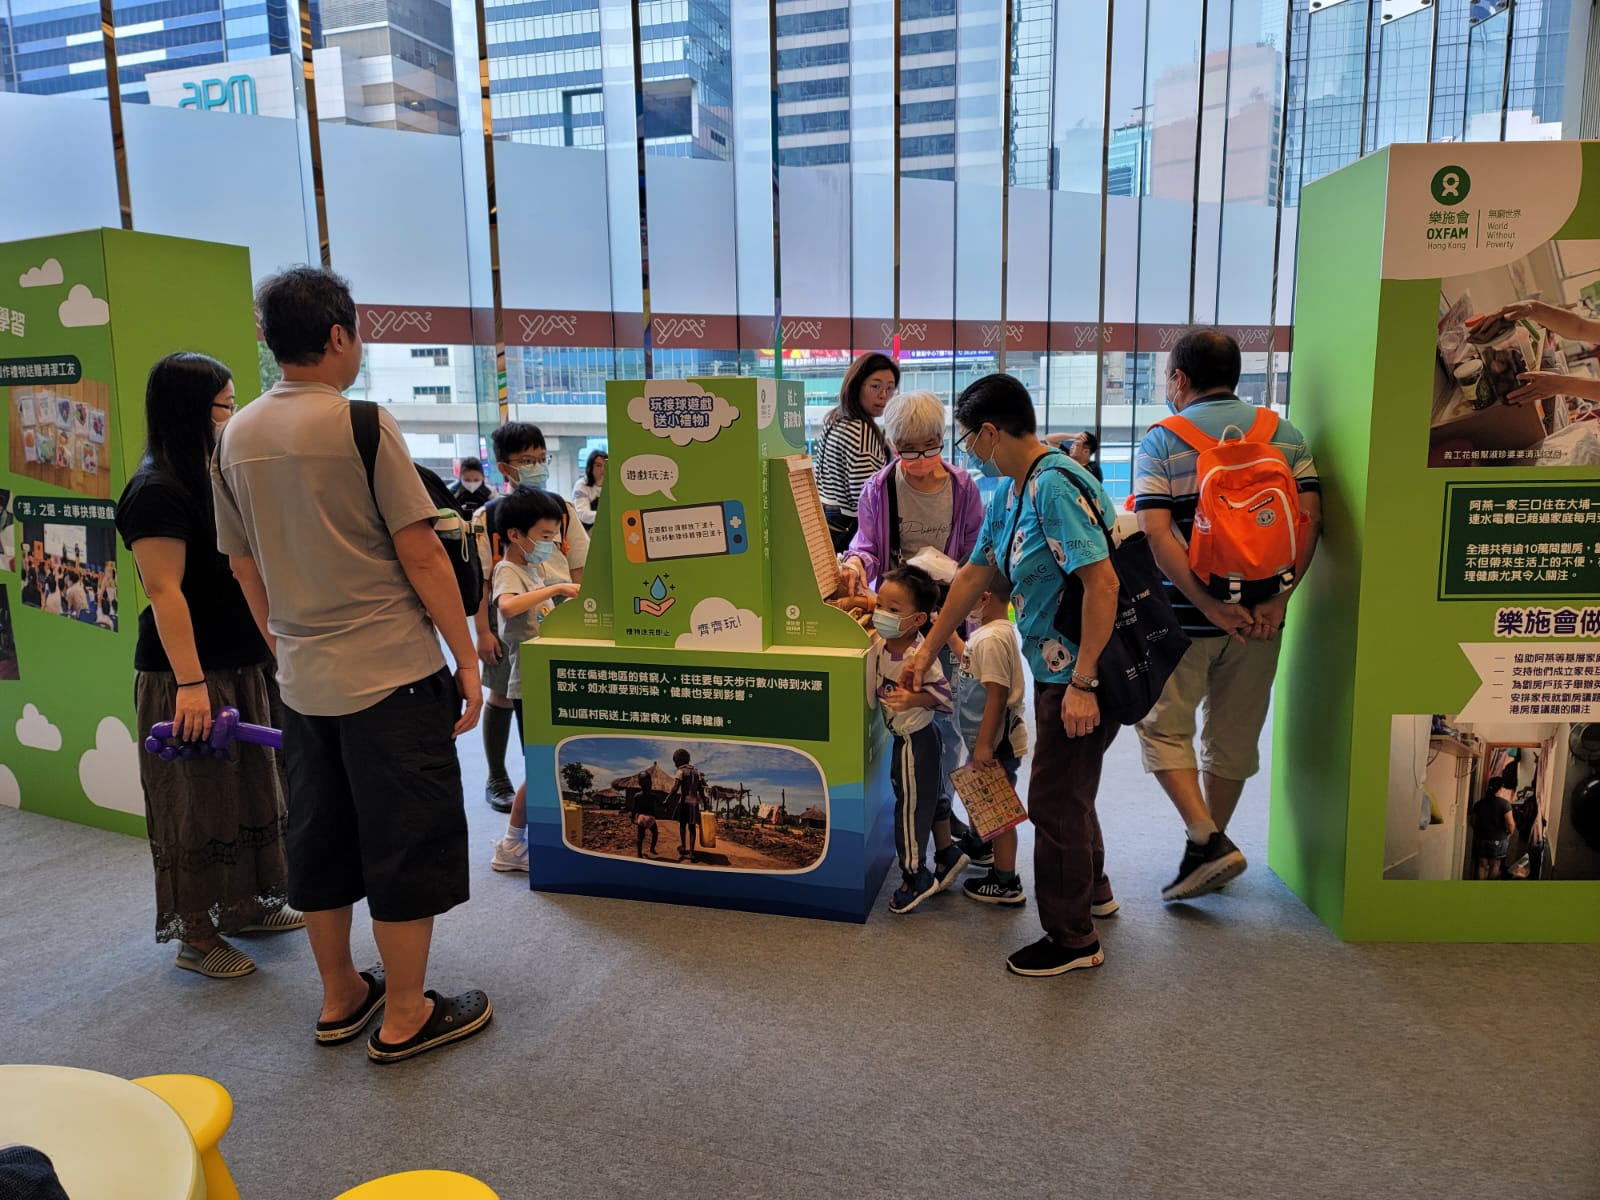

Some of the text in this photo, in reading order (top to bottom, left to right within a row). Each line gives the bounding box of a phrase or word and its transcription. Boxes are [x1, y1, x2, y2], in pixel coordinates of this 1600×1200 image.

[1428, 210, 1470, 225] 樂施會
[1487, 222, 1509, 231] World
[1426, 227, 1469, 240] OXFAM
[1486, 231, 1516, 240] Without
[1427, 240, 1467, 251] Hong Kong
[1485, 240, 1514, 250] Poverty
[649, 396, 714, 412] 玩接球遊戲
